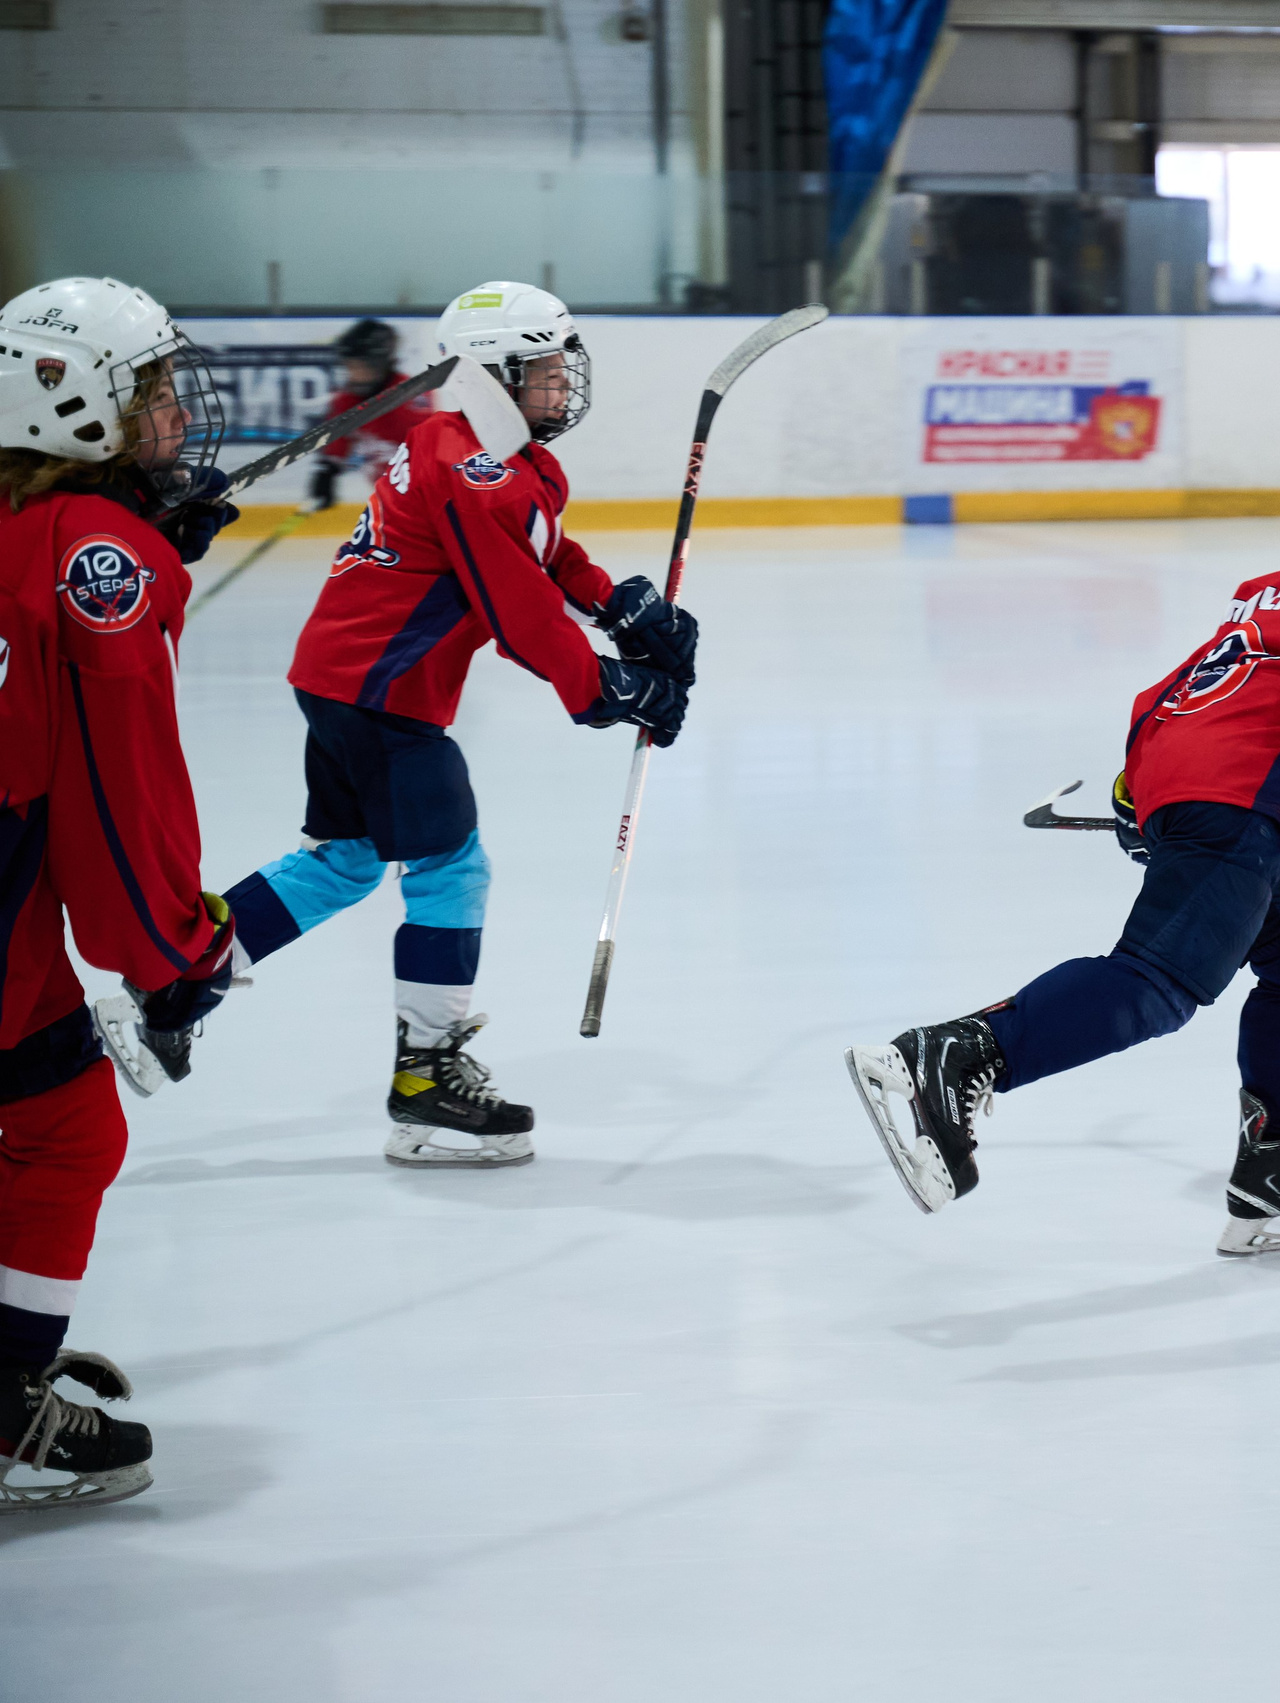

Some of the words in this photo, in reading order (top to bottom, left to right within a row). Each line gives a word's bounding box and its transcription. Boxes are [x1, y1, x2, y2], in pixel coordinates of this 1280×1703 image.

[19, 316, 79, 335] JOFA
[78, 551, 122, 580] 10
[76, 578, 137, 601] STEPS
[615, 814, 631, 853] EAZY
